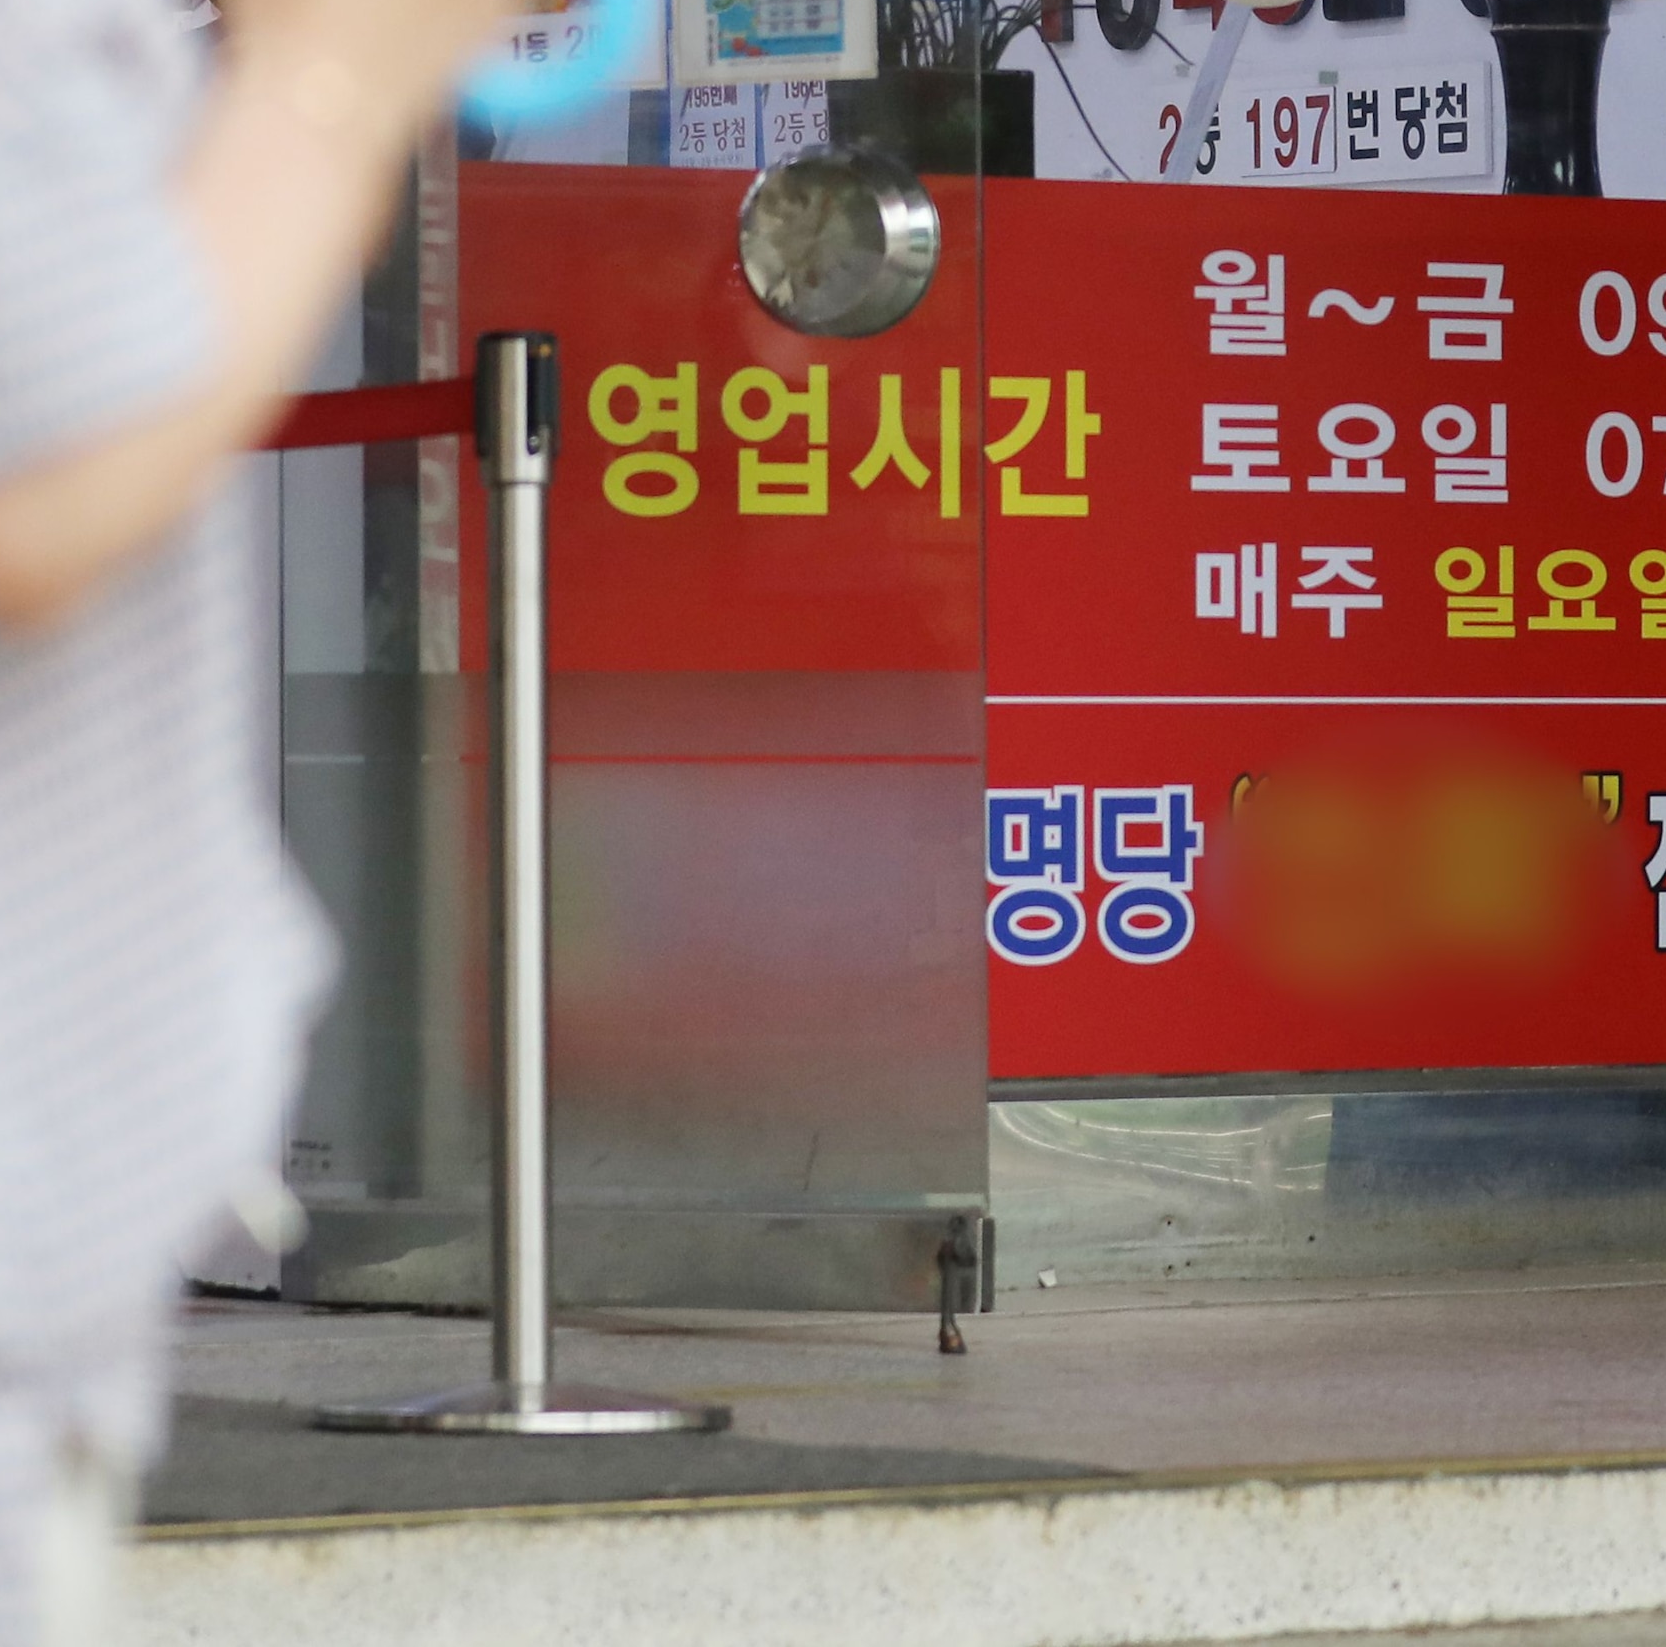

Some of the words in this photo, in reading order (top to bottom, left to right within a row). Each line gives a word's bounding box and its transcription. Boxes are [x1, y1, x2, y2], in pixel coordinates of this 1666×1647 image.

[679, 122, 706, 153] 2등
[713, 117, 746, 151] 당첨
[774, 113, 805, 145] 2등
[1395, 79, 1468, 160] 당첨
[588, 361, 1101, 519] 영업시간
[1191, 401, 1511, 506] 토요일
[1193, 543, 1385, 641] 매주
[985, 784, 1202, 966] 명당
